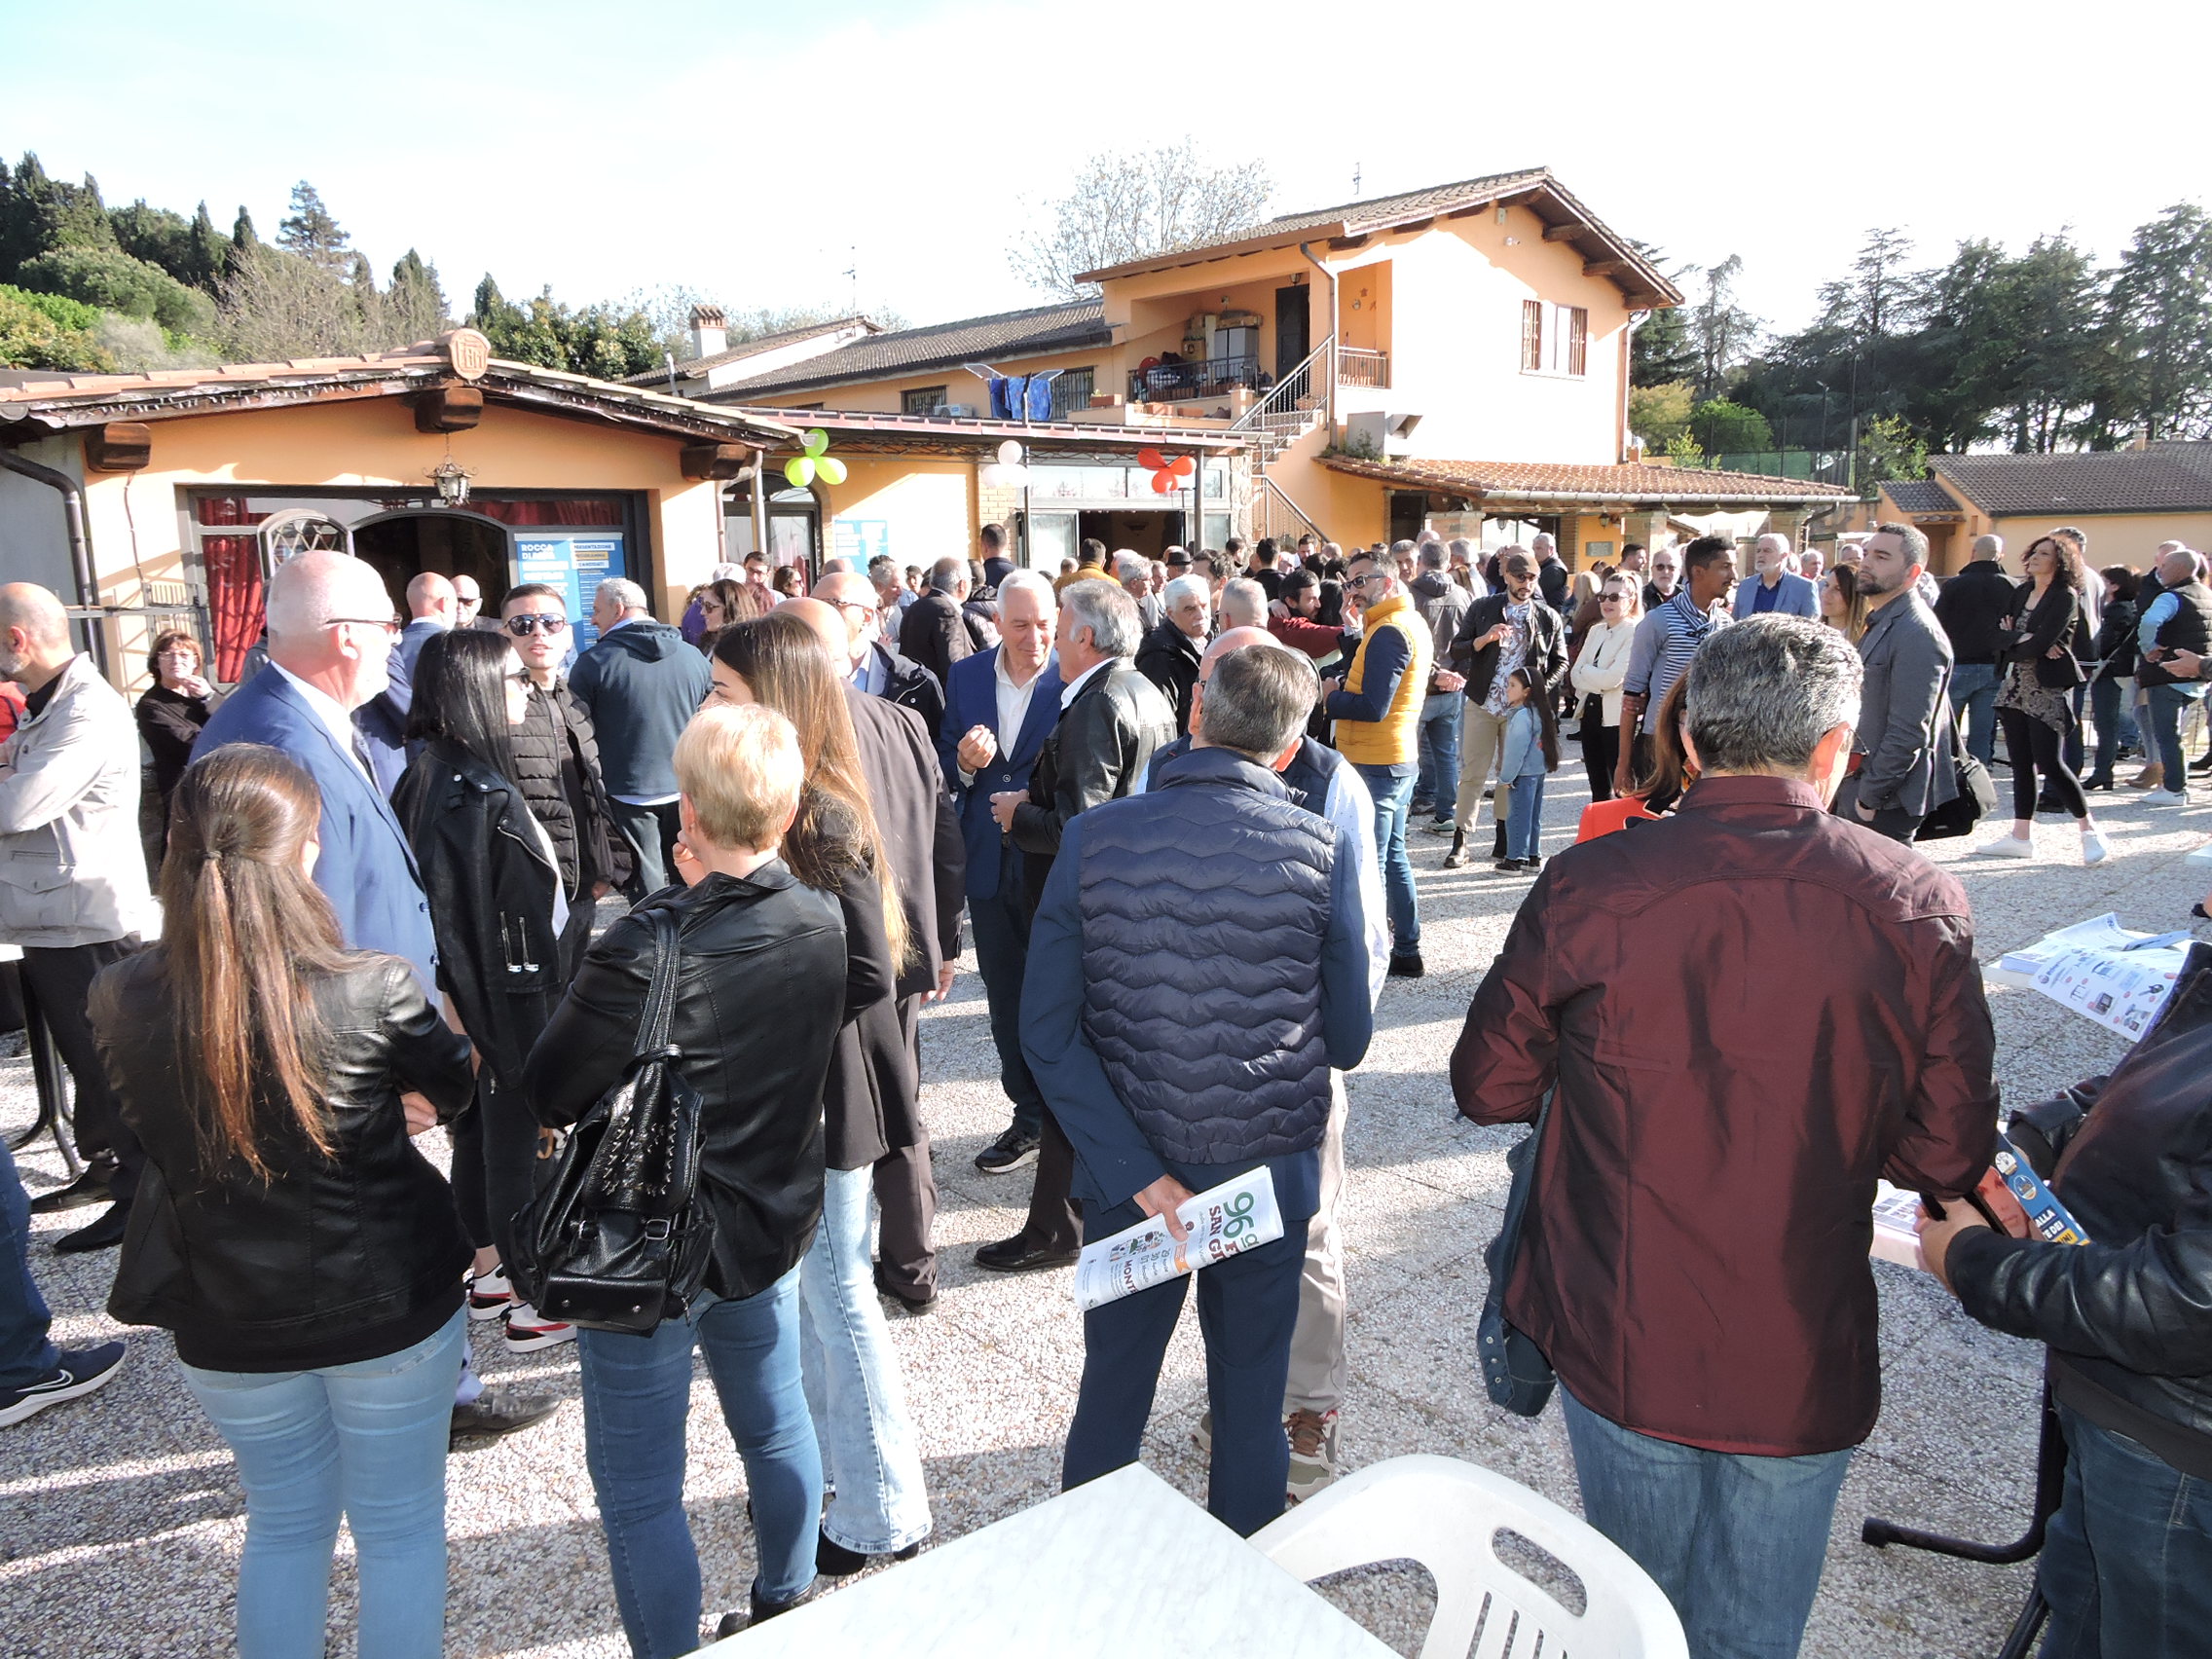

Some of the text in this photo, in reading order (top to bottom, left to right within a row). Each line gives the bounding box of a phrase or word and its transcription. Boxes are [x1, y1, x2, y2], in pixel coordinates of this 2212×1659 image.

[521, 543, 554, 552] ROCCA
[1208, 1205, 1227, 1259] SAN GI
[2049, 1220, 2064, 1235] DEI
[1124, 1259, 1138, 1294] MONTE
